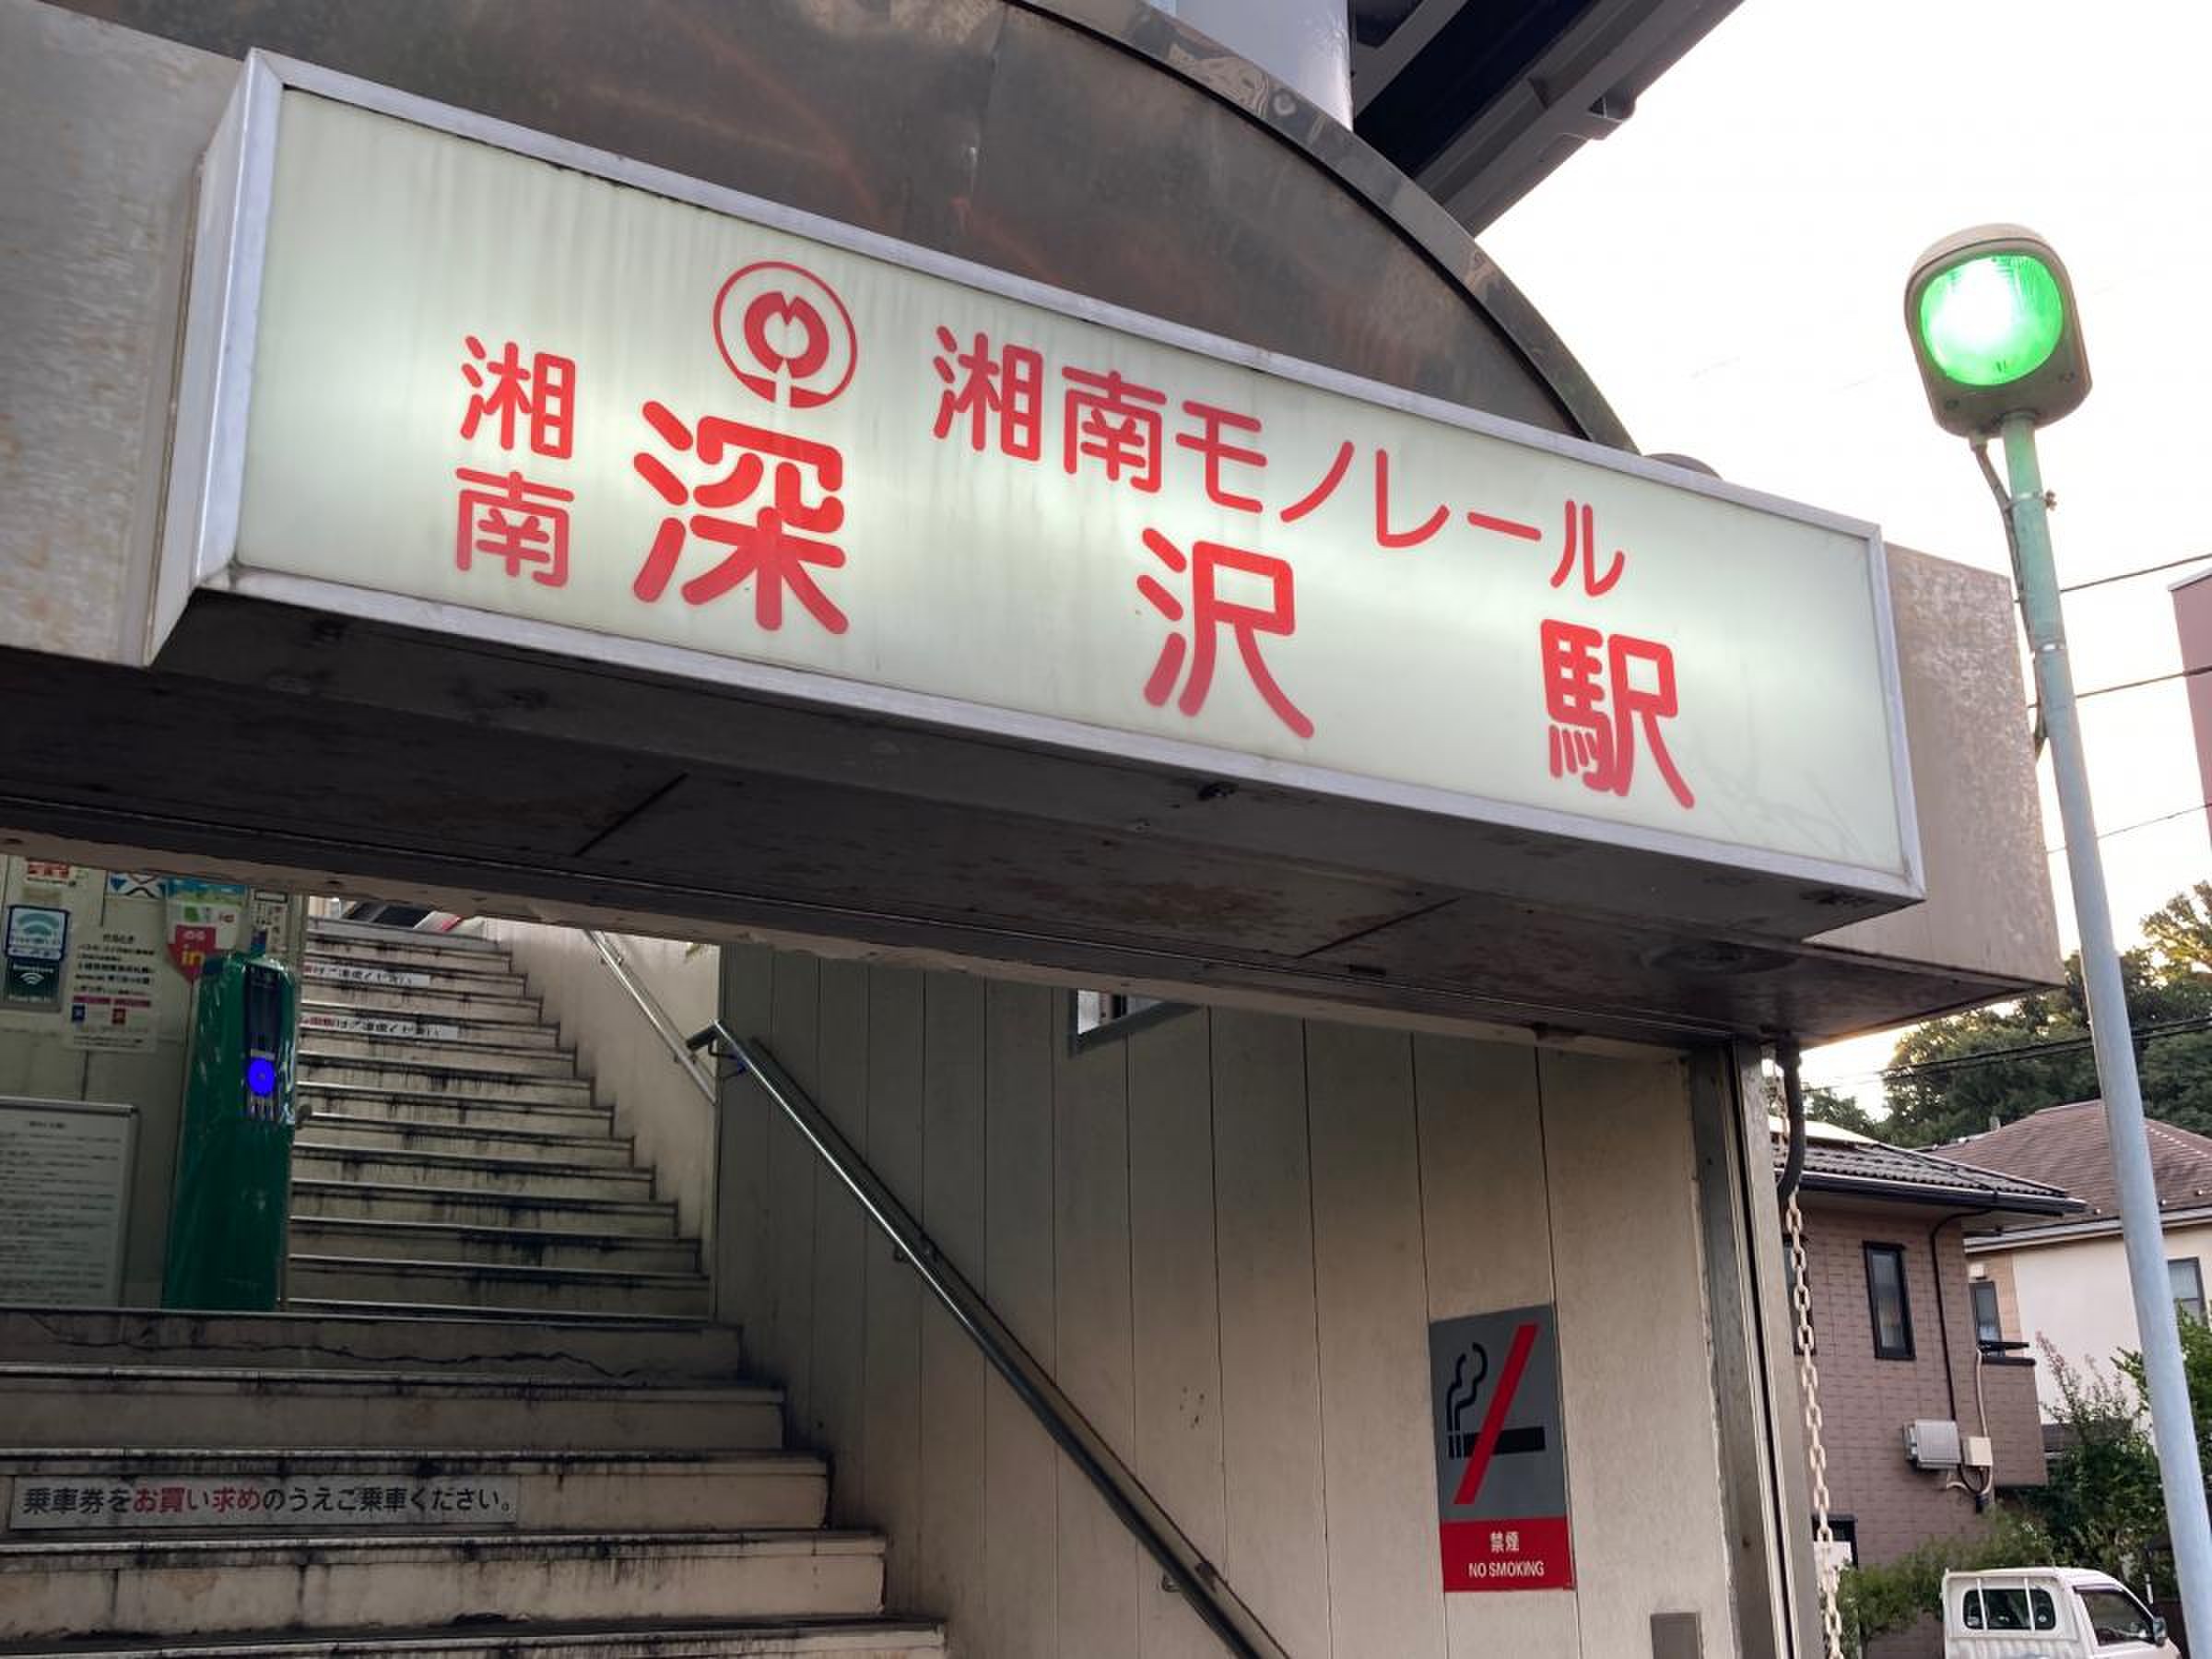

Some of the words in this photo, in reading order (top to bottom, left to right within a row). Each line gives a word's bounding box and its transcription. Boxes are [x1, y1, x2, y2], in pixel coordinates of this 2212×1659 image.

[454, 335, 577, 590] 湘南
[933, 324, 1627, 598] 湘南モノレール
[23, 1486, 510, 1515] 乗車券をお買い求めのうえご乗車ください。
[1490, 1530, 1520, 1554] 禁煙
[1468, 1562, 1487, 1578] NO
[1488, 1559, 1545, 1578] SMOKING
